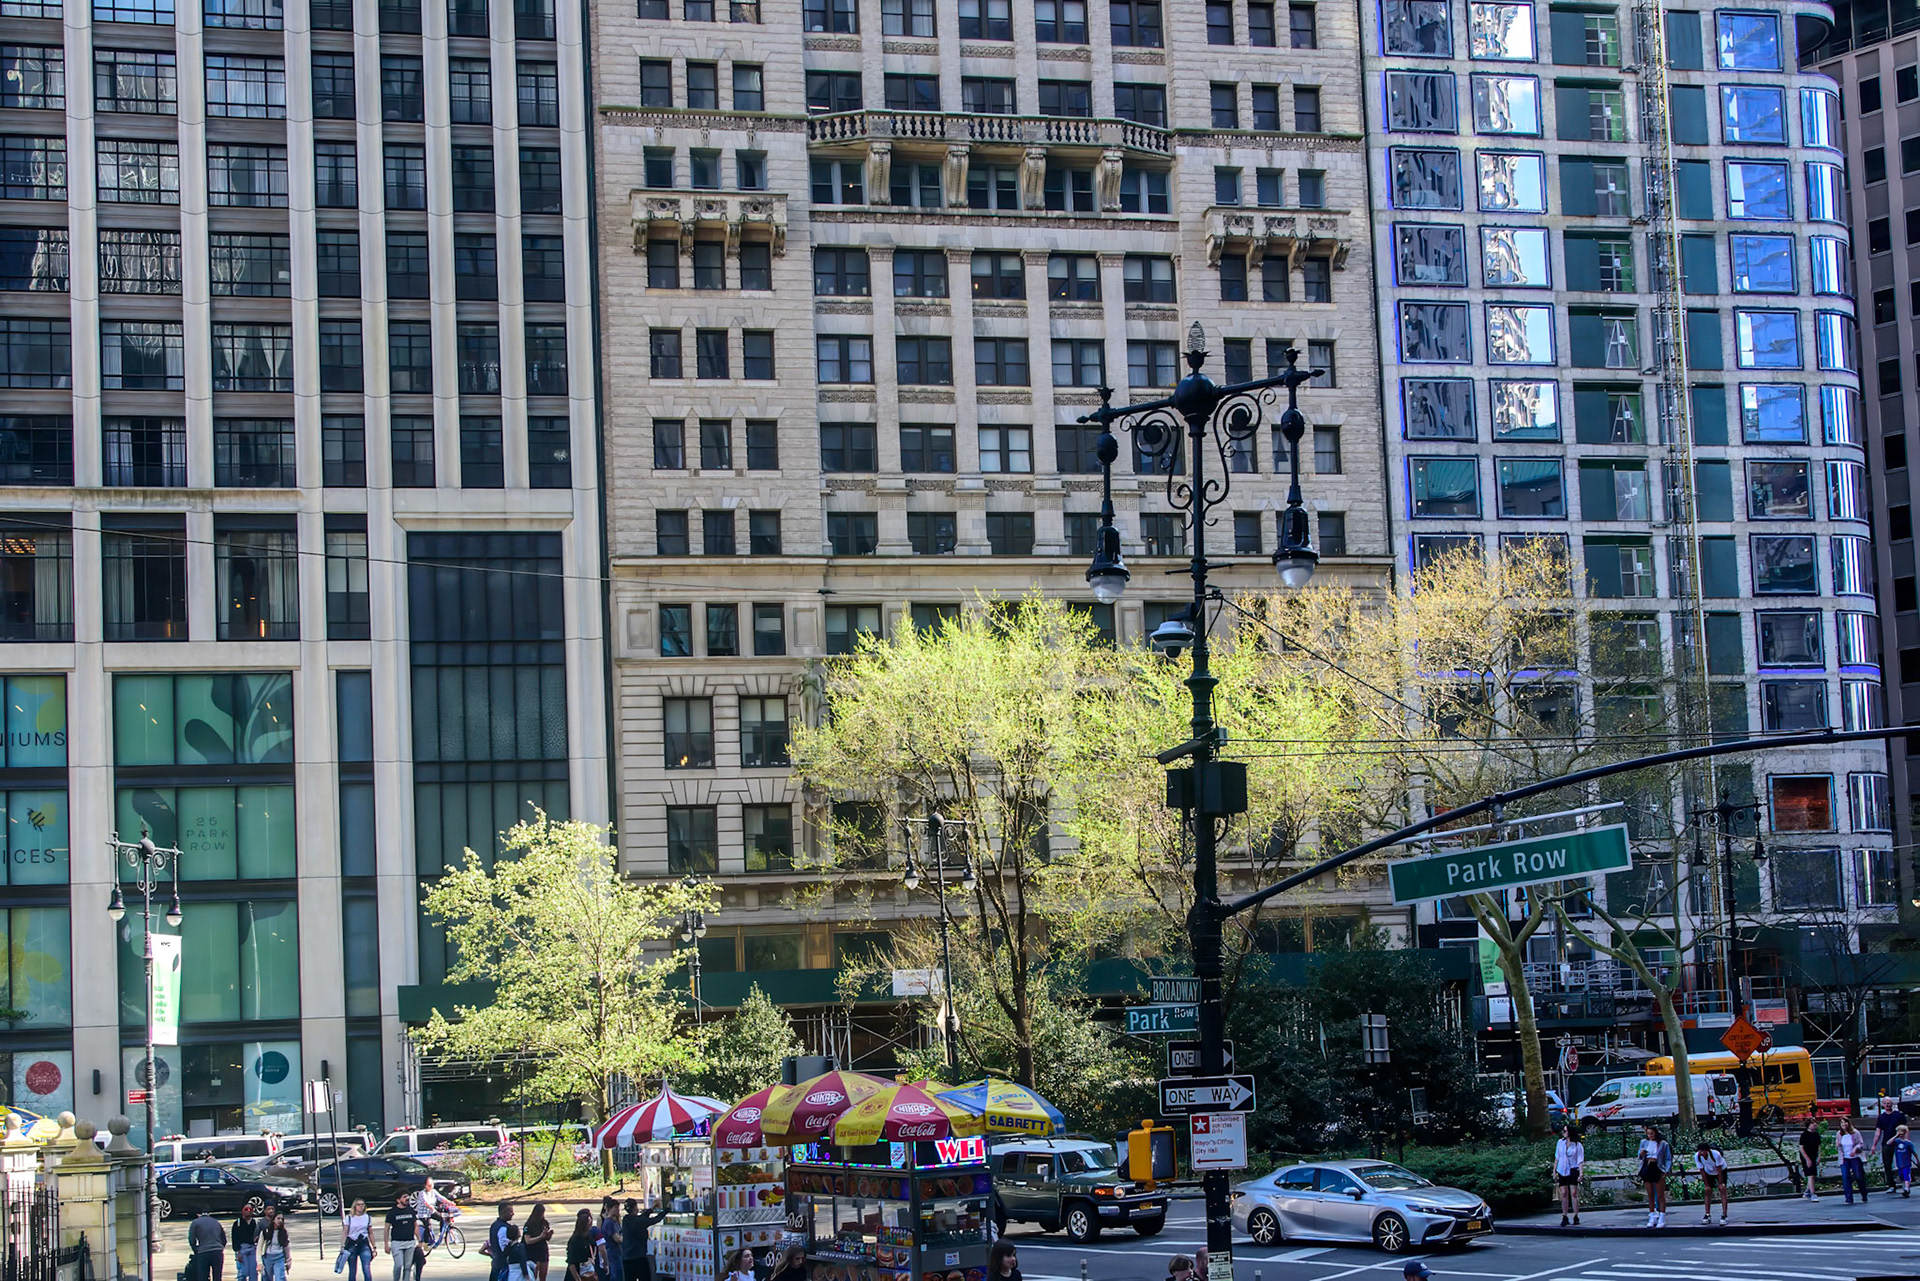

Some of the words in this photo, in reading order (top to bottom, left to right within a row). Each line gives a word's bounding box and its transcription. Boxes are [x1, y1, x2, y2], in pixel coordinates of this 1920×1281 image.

[186, 829, 228, 838] PARK
[190, 841, 225, 851] ROW
[1447, 855, 1502, 885] Park
[1513, 849, 1566, 875] Row
[1153, 981, 1199, 1001] BROADWAY
[1129, 1008, 1170, 1031] Park
[1174, 1007, 1194, 1018] Row
[1174, 1052, 1195, 1066] ONE
[1169, 1089, 1196, 1103] ONE
[1211, 1087, 1240, 1102] WAY
[989, 1115, 1046, 1131] SABRETT
